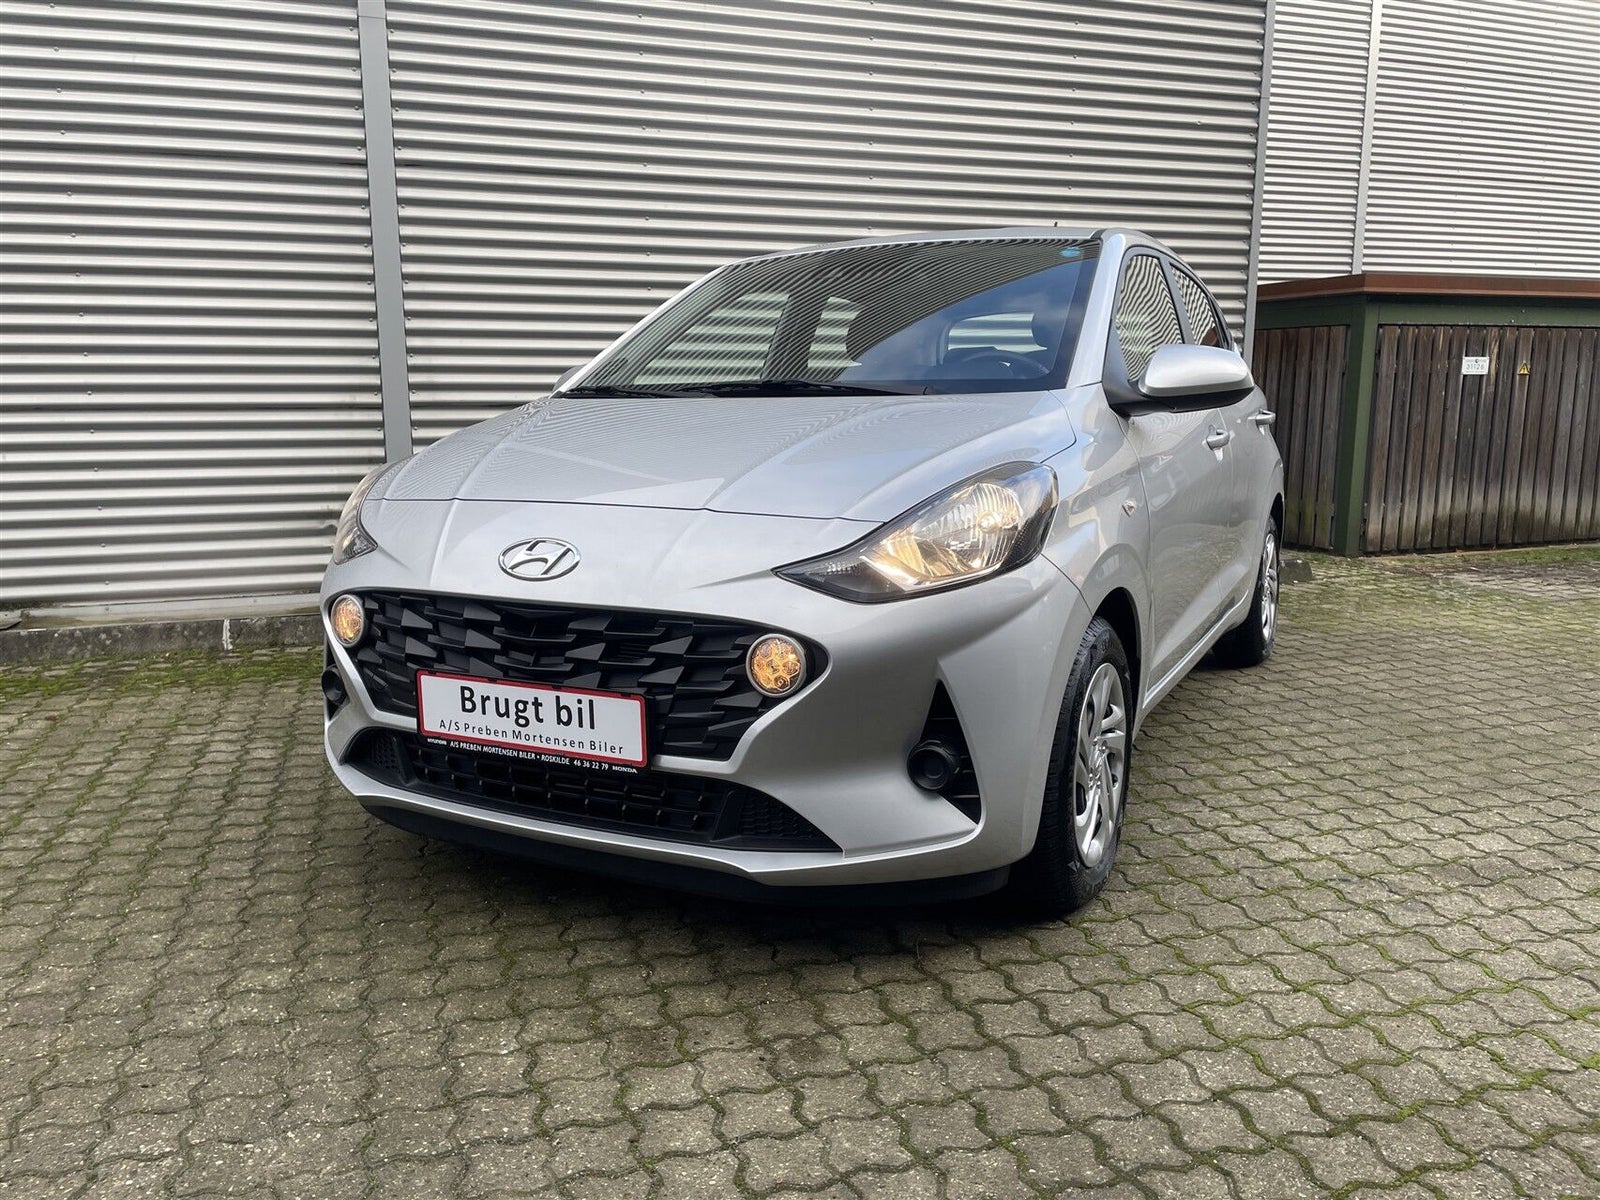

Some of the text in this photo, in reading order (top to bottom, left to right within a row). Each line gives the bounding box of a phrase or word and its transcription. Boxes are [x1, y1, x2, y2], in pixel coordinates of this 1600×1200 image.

[460, 685, 595, 730] Brugt bil
[439, 719, 623, 754] A/S Preben Mortensen Biler
[449, 740, 460, 749] A/S
[460, 742, 482, 752] PREBEN
[482, 745, 518, 757] MORTENSEN
[518, 751, 536, 760] BILER
[540, 754, 570, 765] ROSKILDE
[573, 759, 582, 767] 46
[583, 760, 590, 768] 36
[601, 763, 609, 771] 79
[612, 765, 638, 774] HONDA
